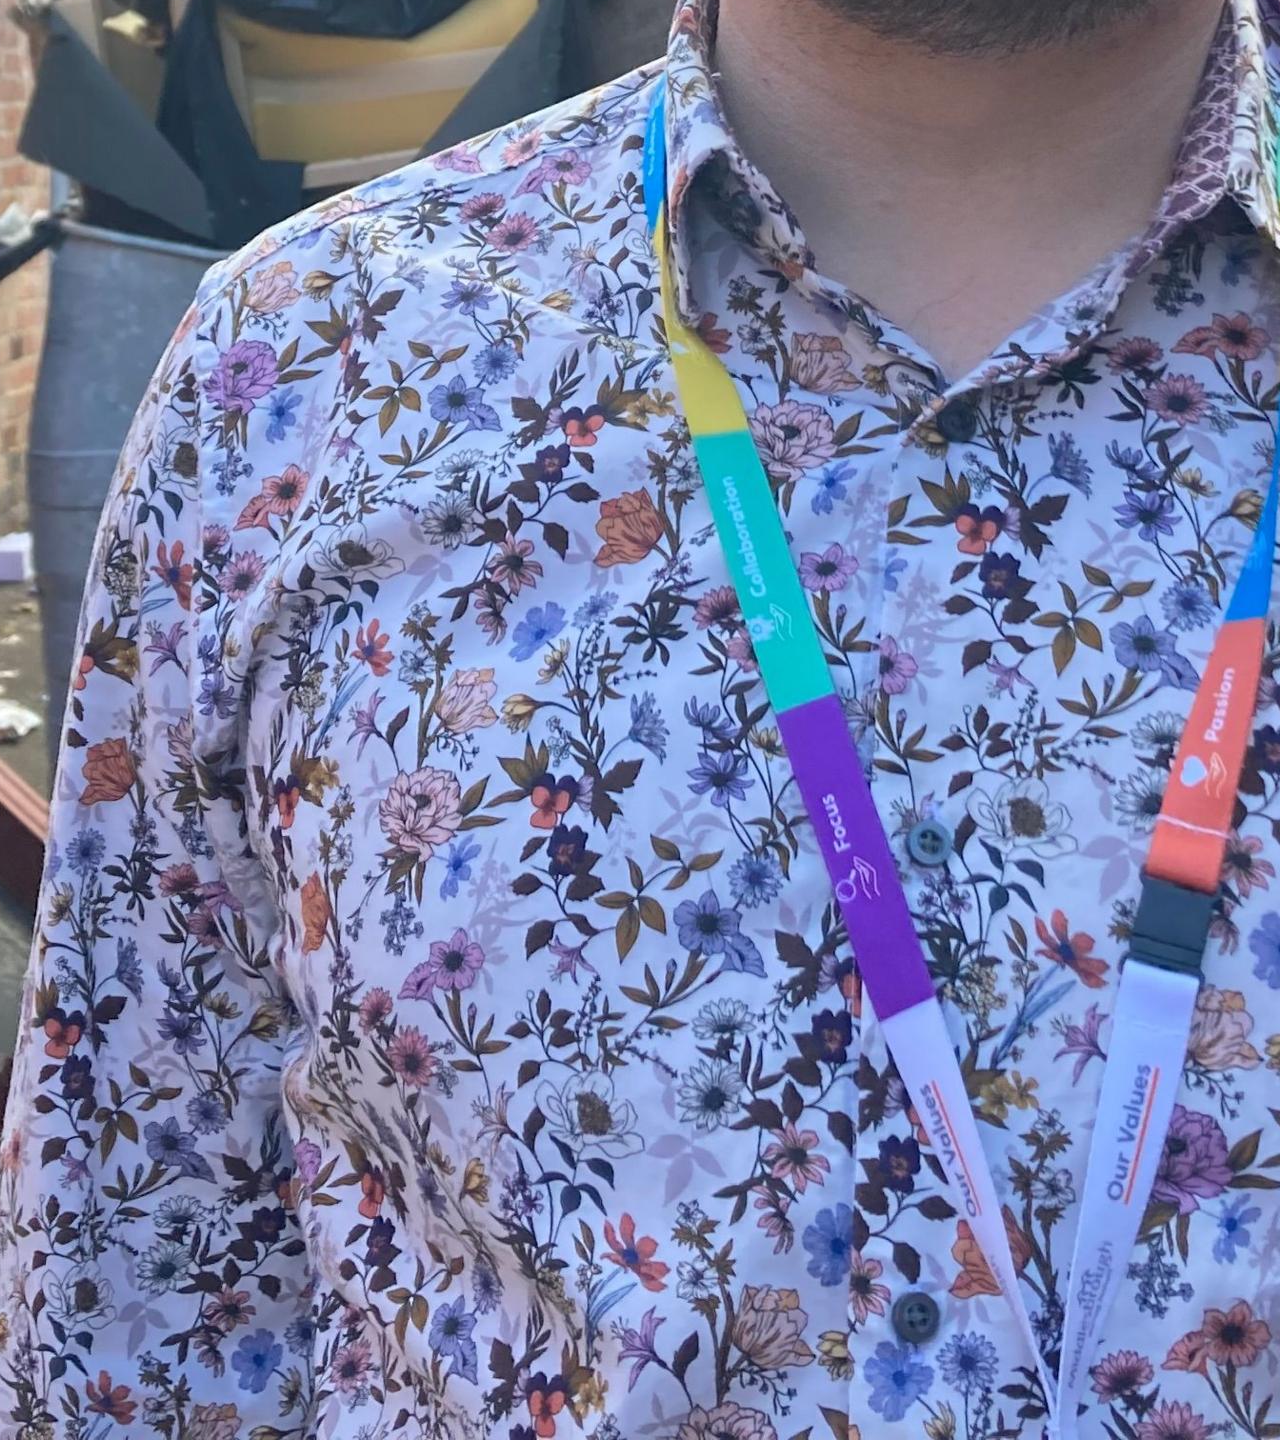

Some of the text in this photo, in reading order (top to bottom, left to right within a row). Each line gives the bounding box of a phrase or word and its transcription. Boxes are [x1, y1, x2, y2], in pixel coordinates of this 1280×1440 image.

[722, 475, 767, 598] Collaboration
[1203, 667, 1236, 743] Passion
[822, 793, 852, 853] Focus
[920, 1084, 977, 1218] Our Values
[1107, 1063, 1152, 1202] Our Values
